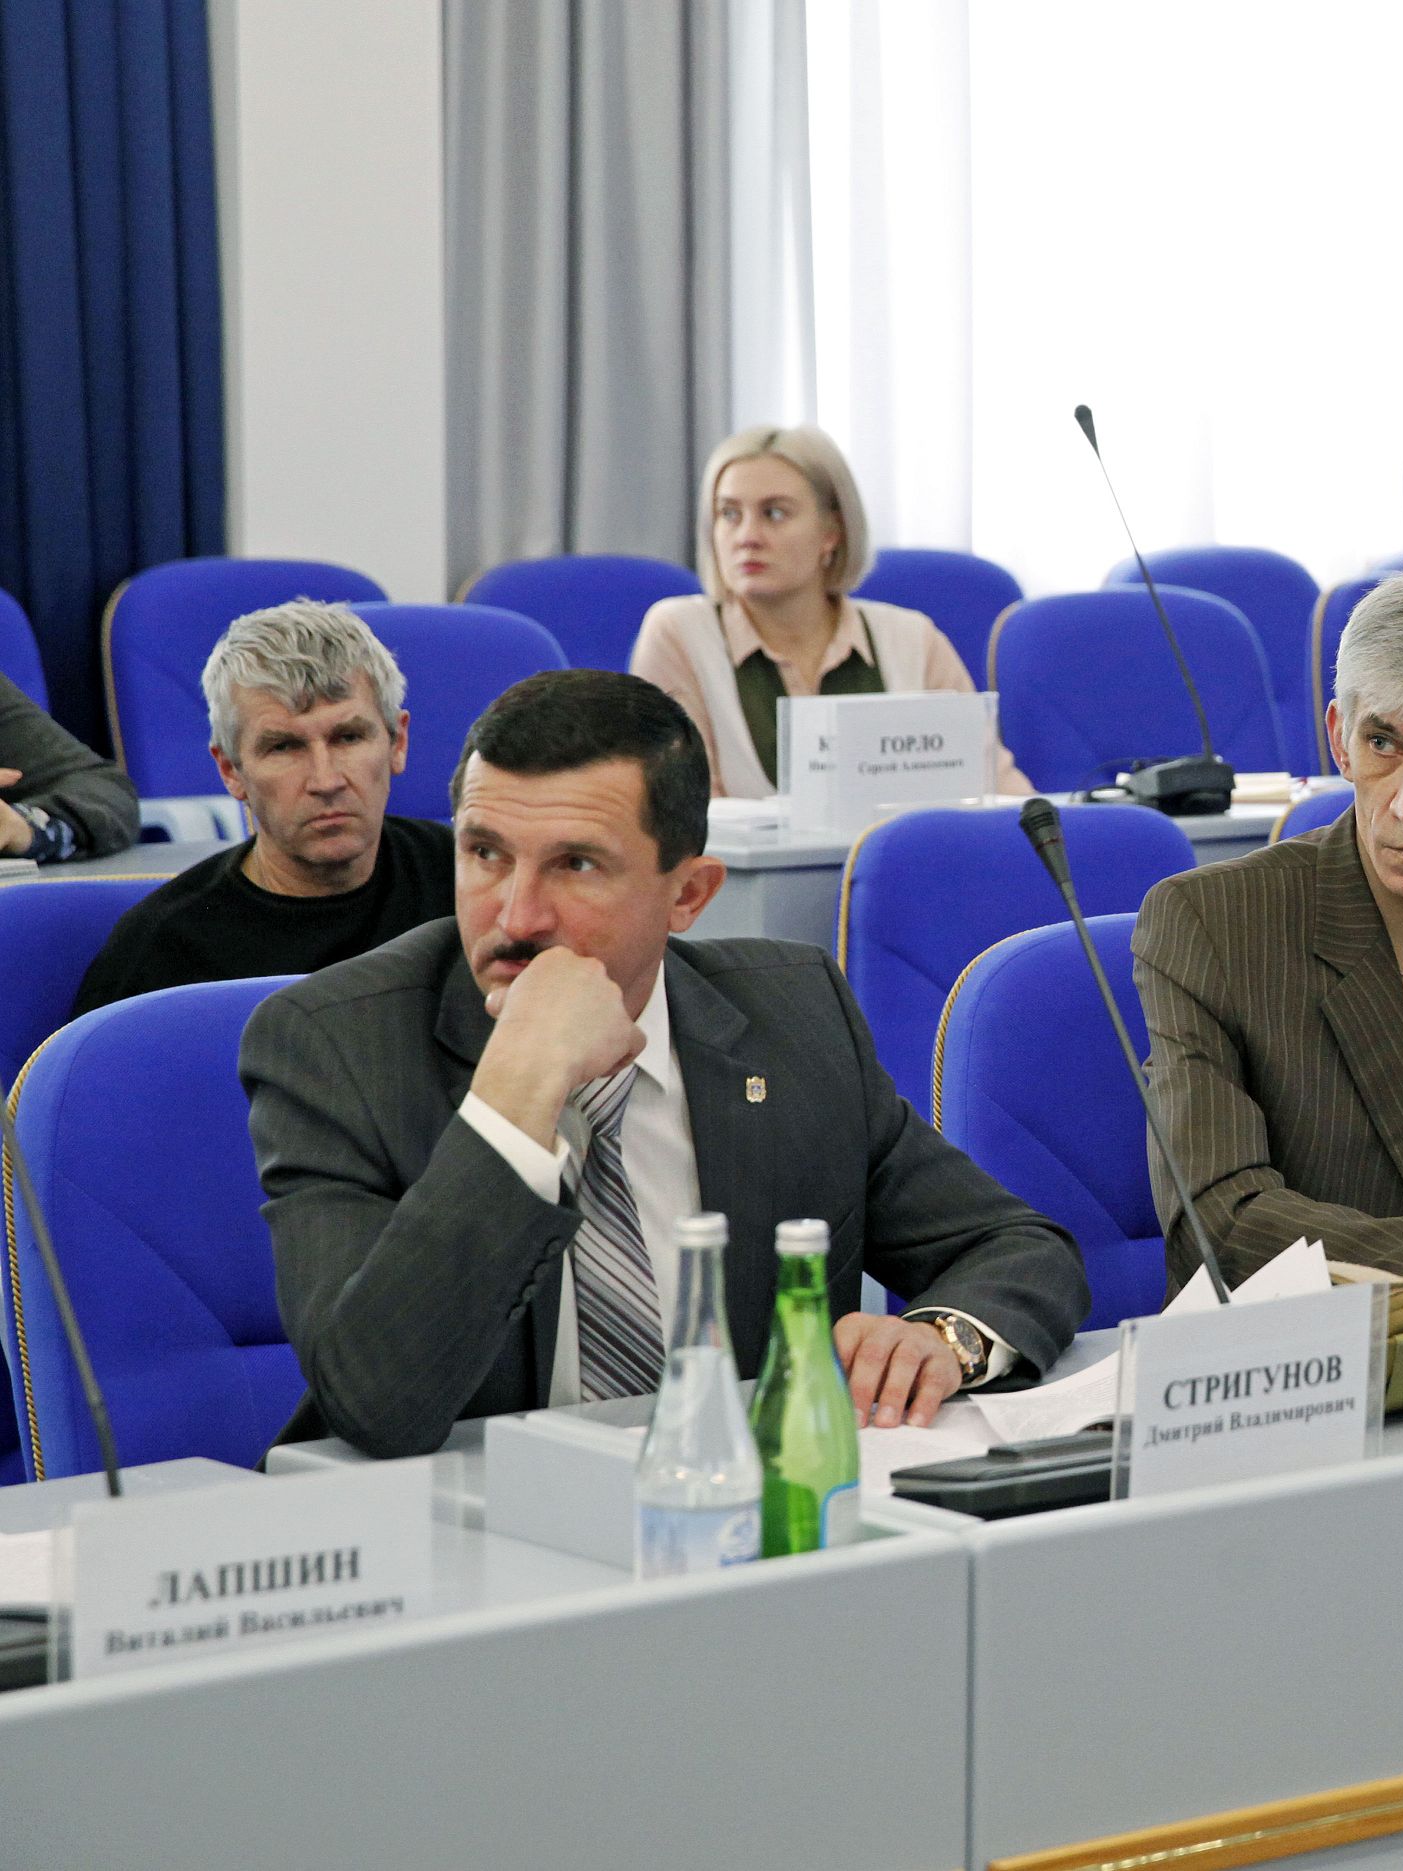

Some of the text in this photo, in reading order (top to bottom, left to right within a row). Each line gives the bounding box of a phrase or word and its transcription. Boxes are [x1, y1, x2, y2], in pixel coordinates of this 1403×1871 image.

[879, 732, 944, 754] ГОРЛО
[1163, 1354, 1343, 1410] СТРИГУНОВ
[1142, 1396, 1356, 1448] Дмитрий Владимирович
[147, 1545, 362, 1608] ЛАПШИН
[105, 1595, 405, 1655] Виталий Васильевич
